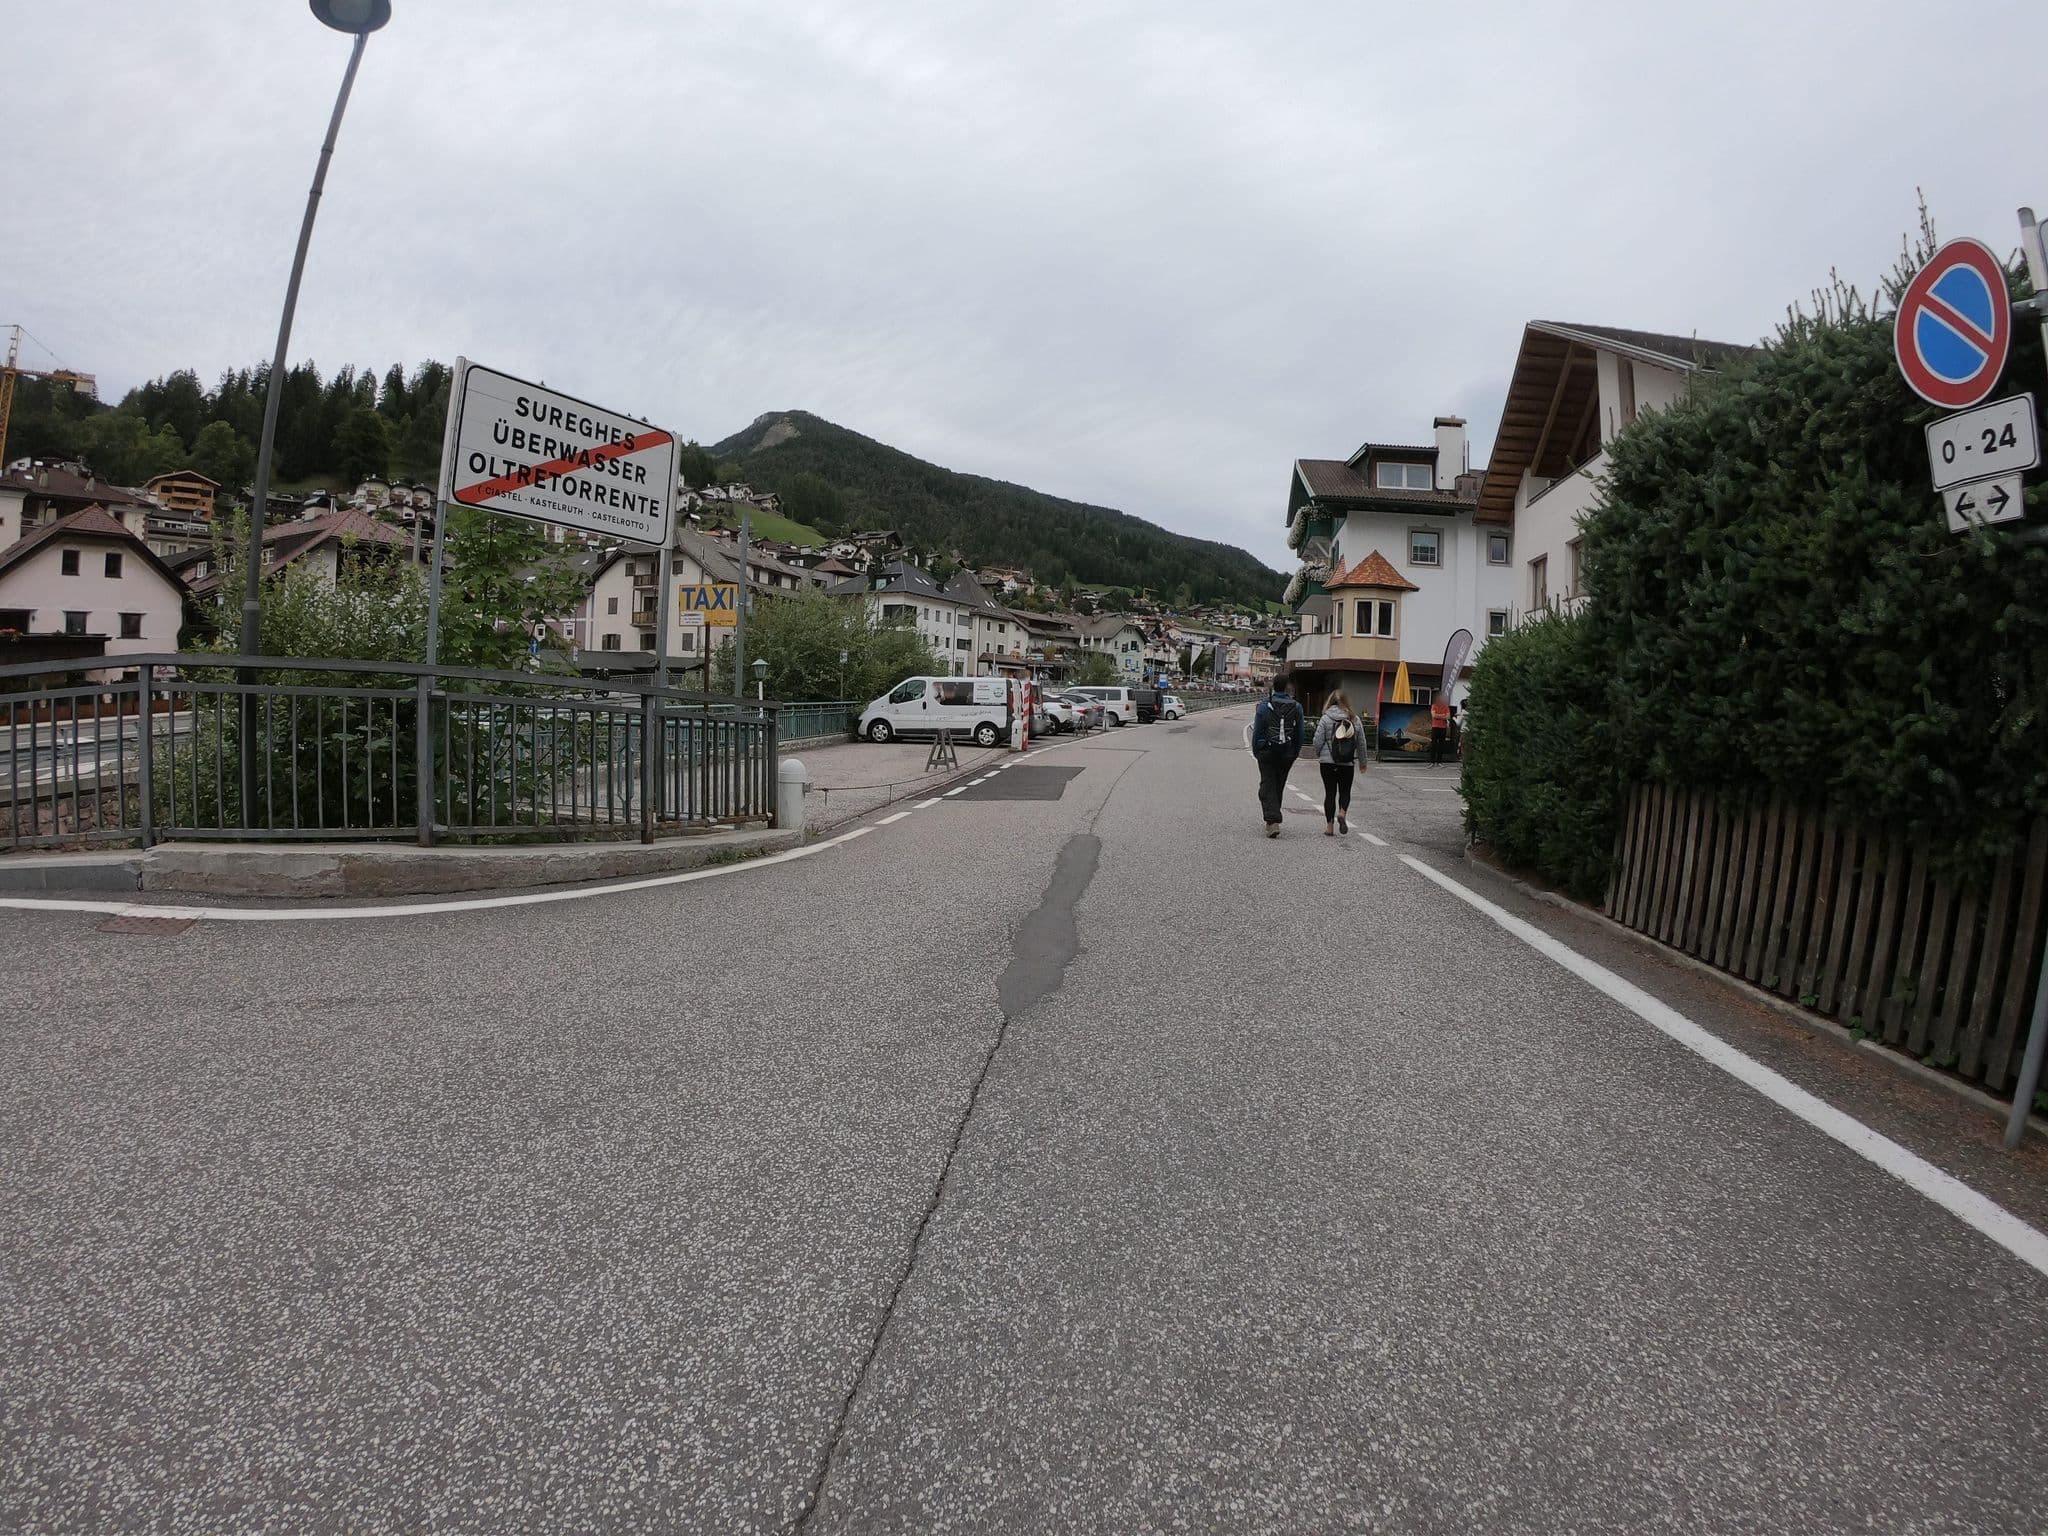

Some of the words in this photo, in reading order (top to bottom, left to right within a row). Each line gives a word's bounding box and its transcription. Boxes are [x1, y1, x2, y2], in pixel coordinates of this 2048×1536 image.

[515, 396, 635, 450] SUREGHES
[1942, 440, 1955, 464] 0
[1981, 423, 2017, 454] 24
[493, 418, 647, 485] ÜBERWASSER
[469, 452, 660, 518] OLTRETORRENTE
[530, 496, 584, 516] KASTELRUTH
[592, 511, 644, 530] CASTELROTTO
[682, 587, 734, 610] TAXI
